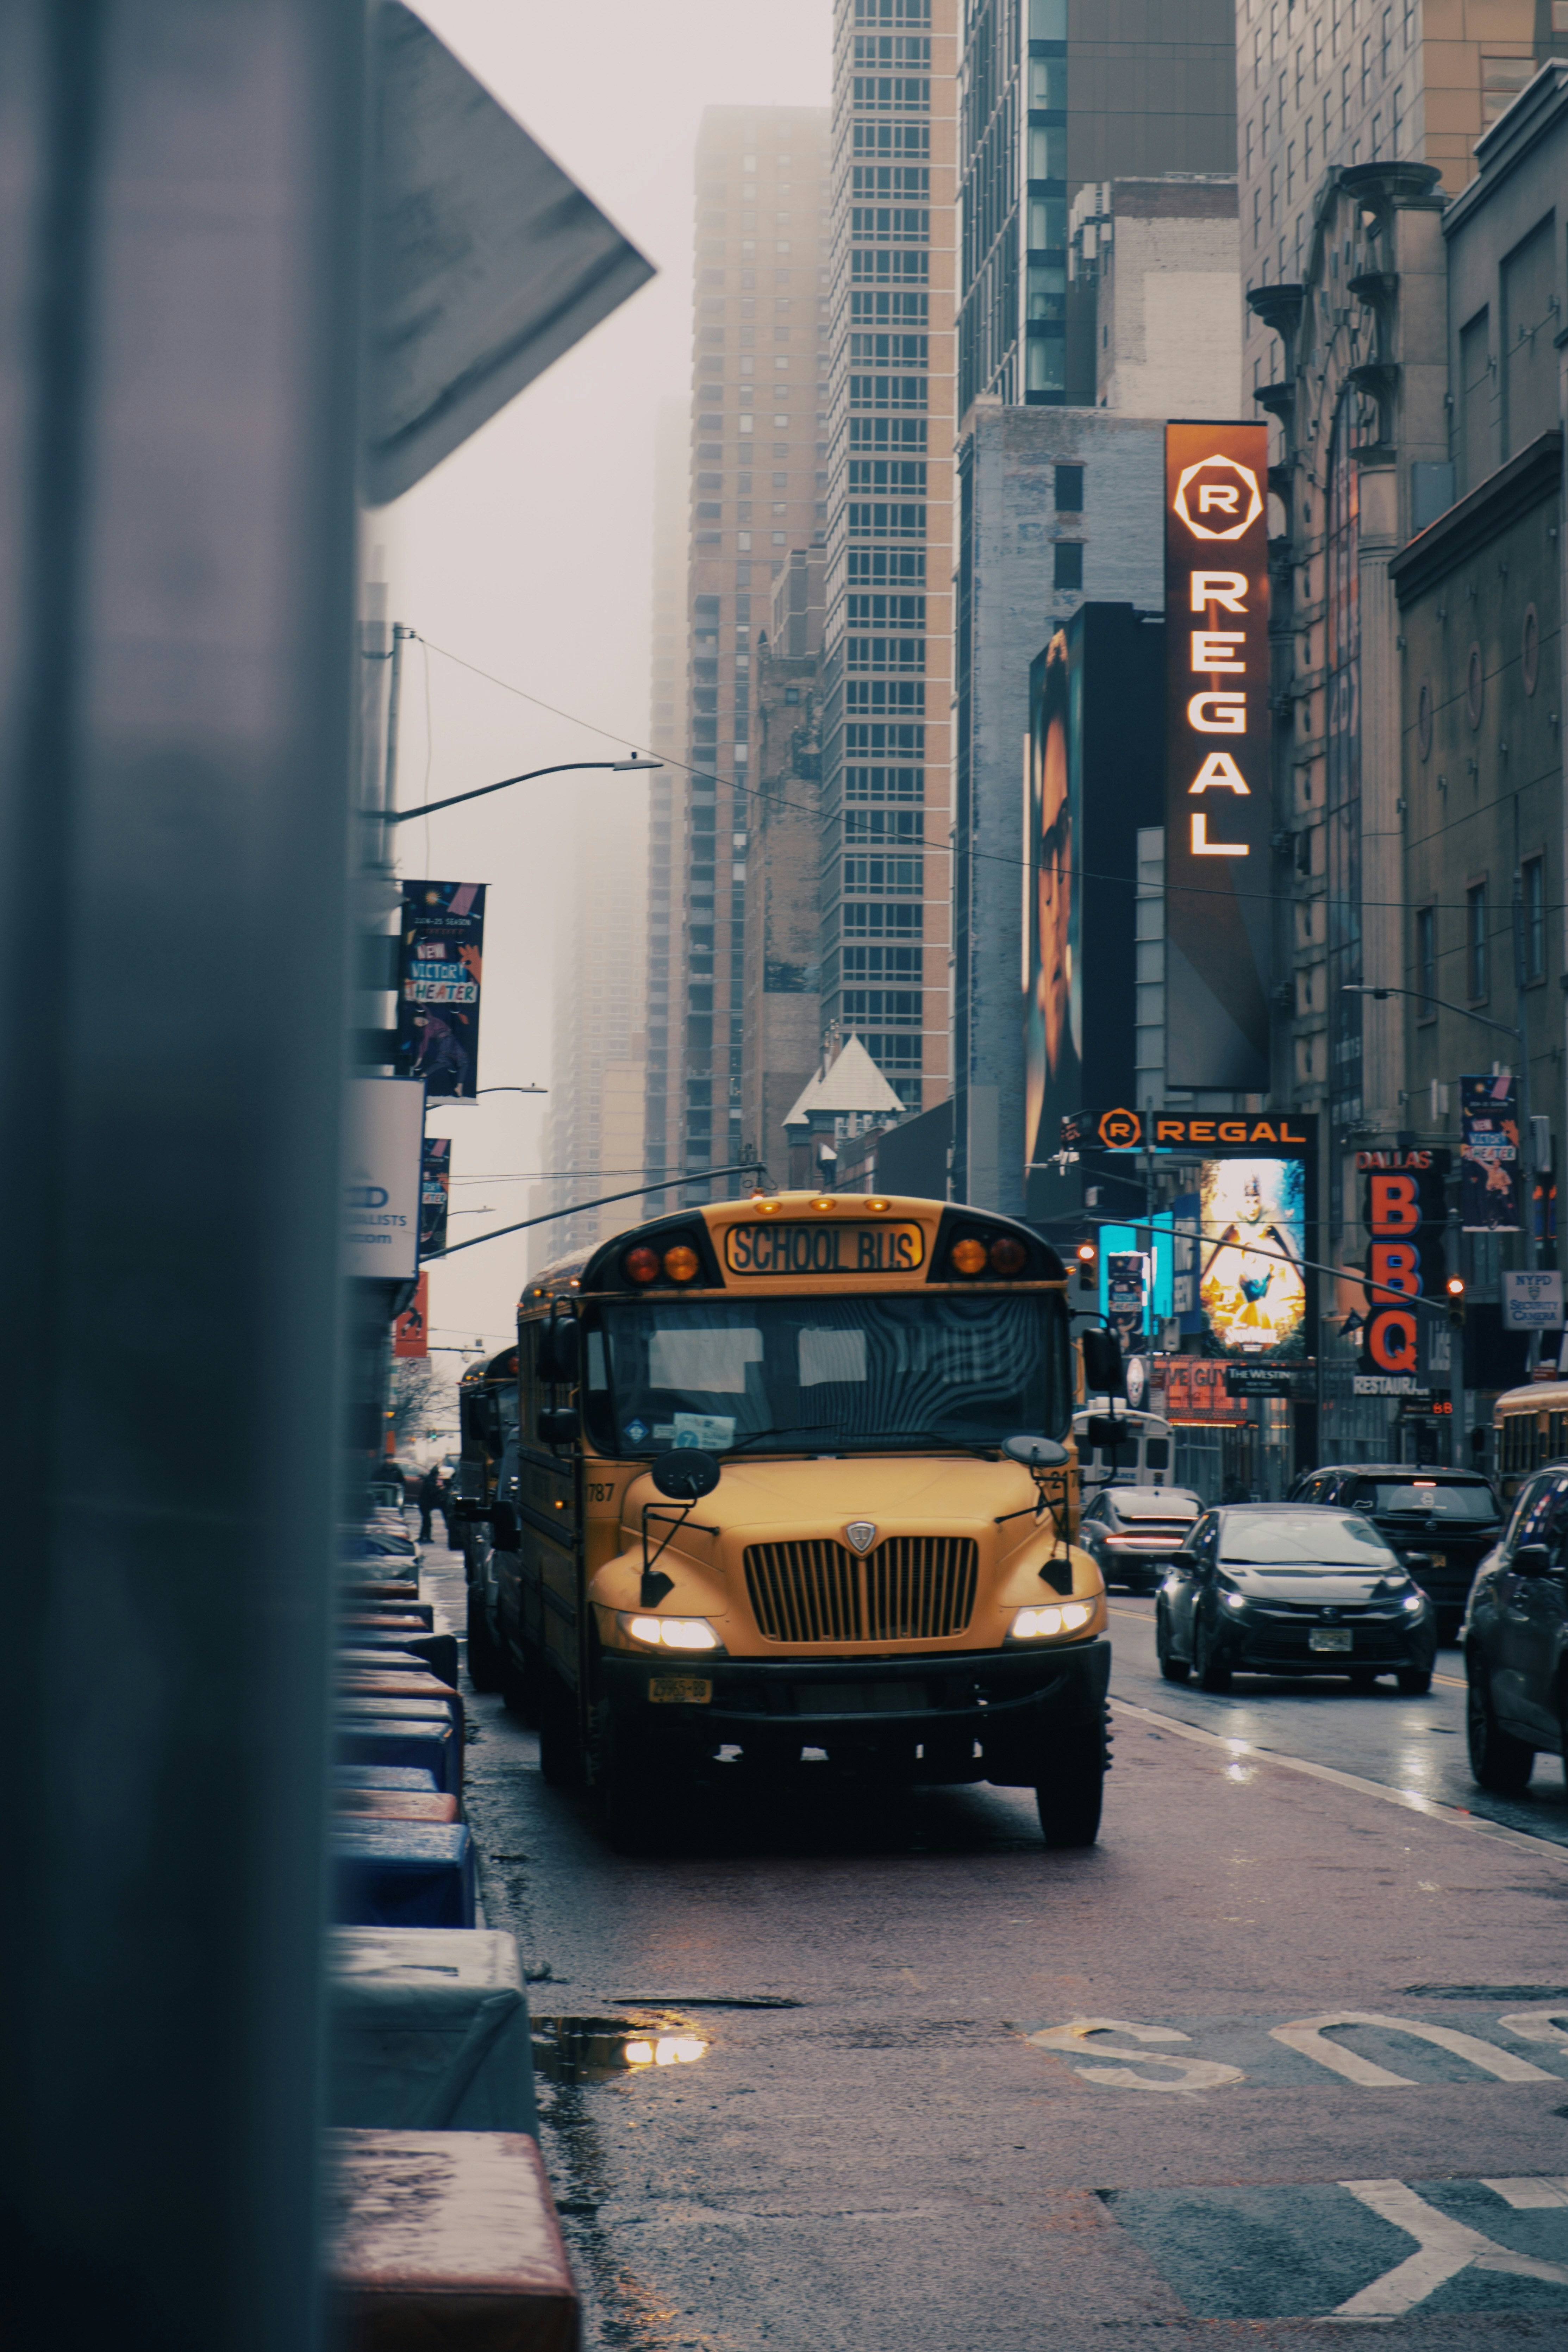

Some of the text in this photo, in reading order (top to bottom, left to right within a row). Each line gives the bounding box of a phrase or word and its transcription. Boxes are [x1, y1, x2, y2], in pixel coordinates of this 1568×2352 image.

[1188, 571, 1251, 855] REGAL
[417, 943, 445, 958] NEW
[411, 962, 466, 979] VICTORY
[405, 981, 473, 1001] THEATER
[1110, 1121, 1306, 1143] R REGAL
[1356, 1151, 1434, 1169] DALLAS
[1465, 1147, 1513, 1159] THEATER
[734, 1226, 913, 1270] SCHOOL BUS
[1369, 1173, 1421, 1372] BBQ
[1516, 1275, 1552, 1285] NYPD
[1228, 1368, 1291, 1380] THE WESTIN
